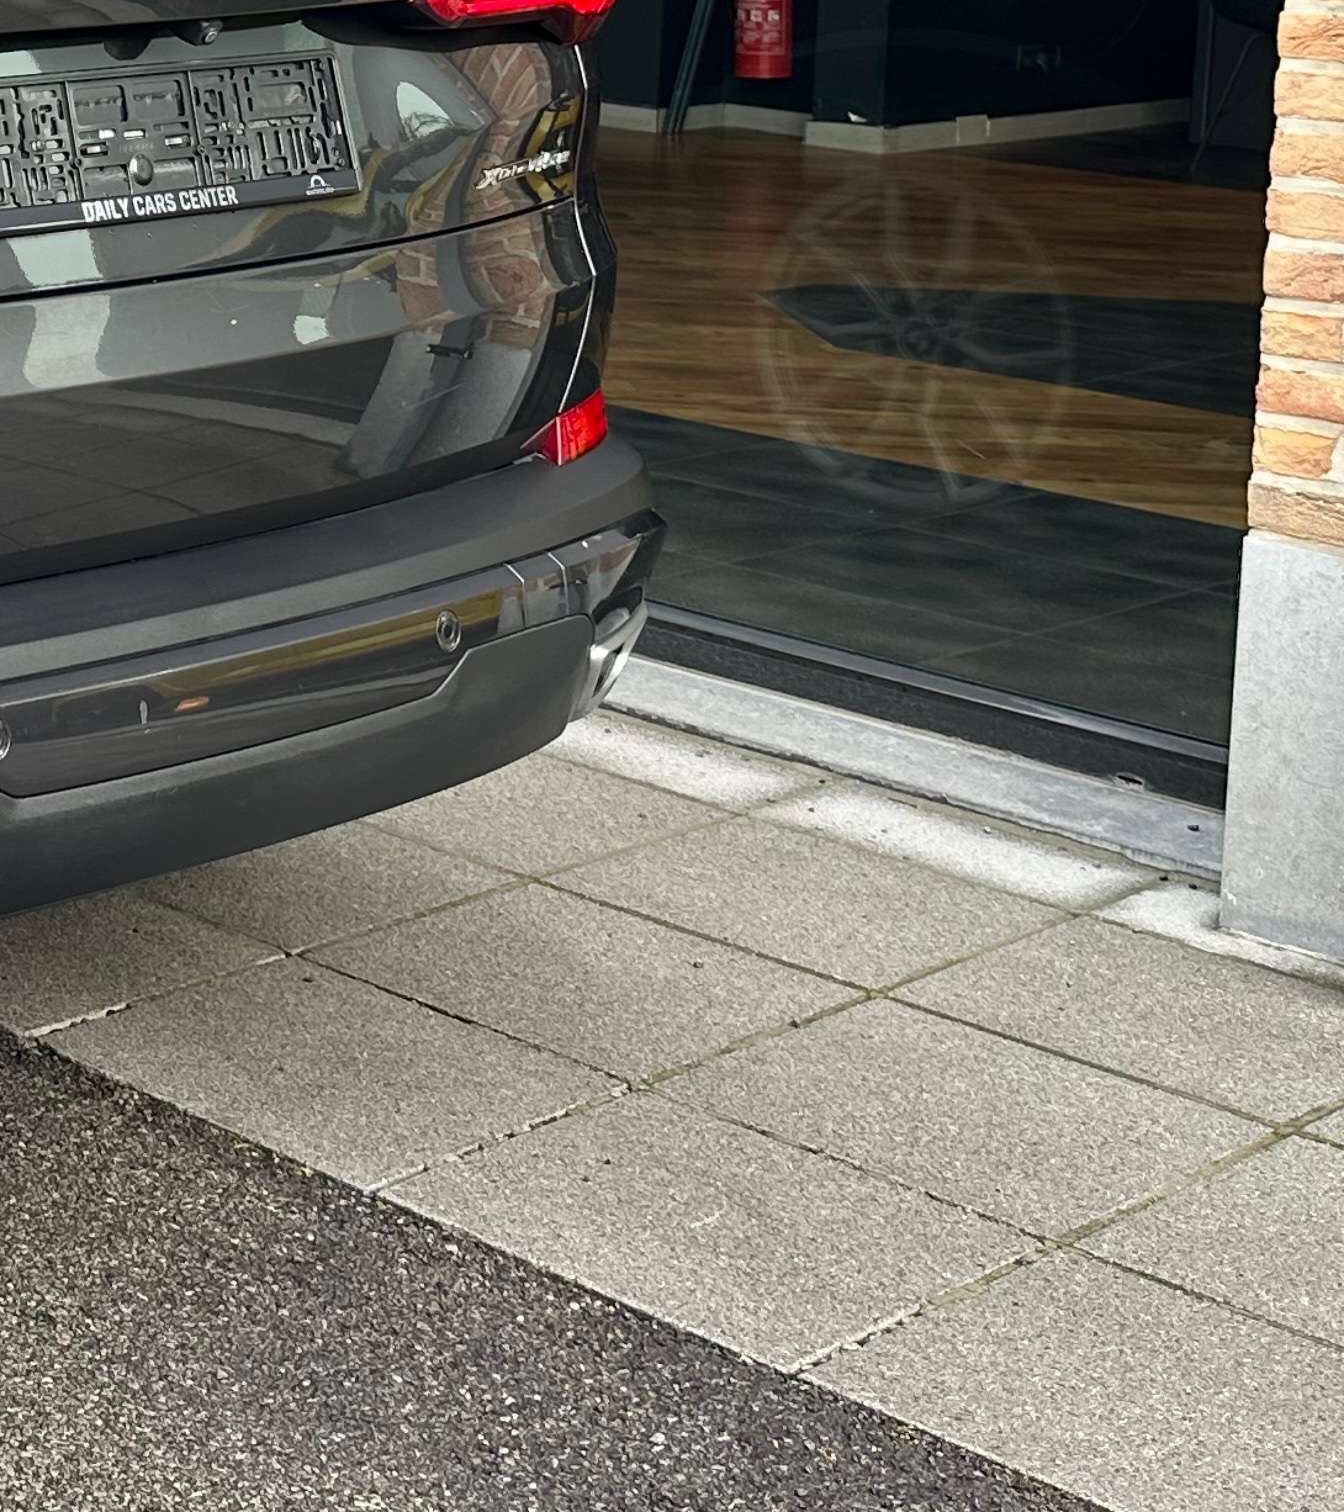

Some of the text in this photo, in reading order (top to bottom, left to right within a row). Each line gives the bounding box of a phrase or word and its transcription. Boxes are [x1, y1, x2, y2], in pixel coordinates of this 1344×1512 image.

[81, 185, 239, 223] DAILY CARS CENTER
